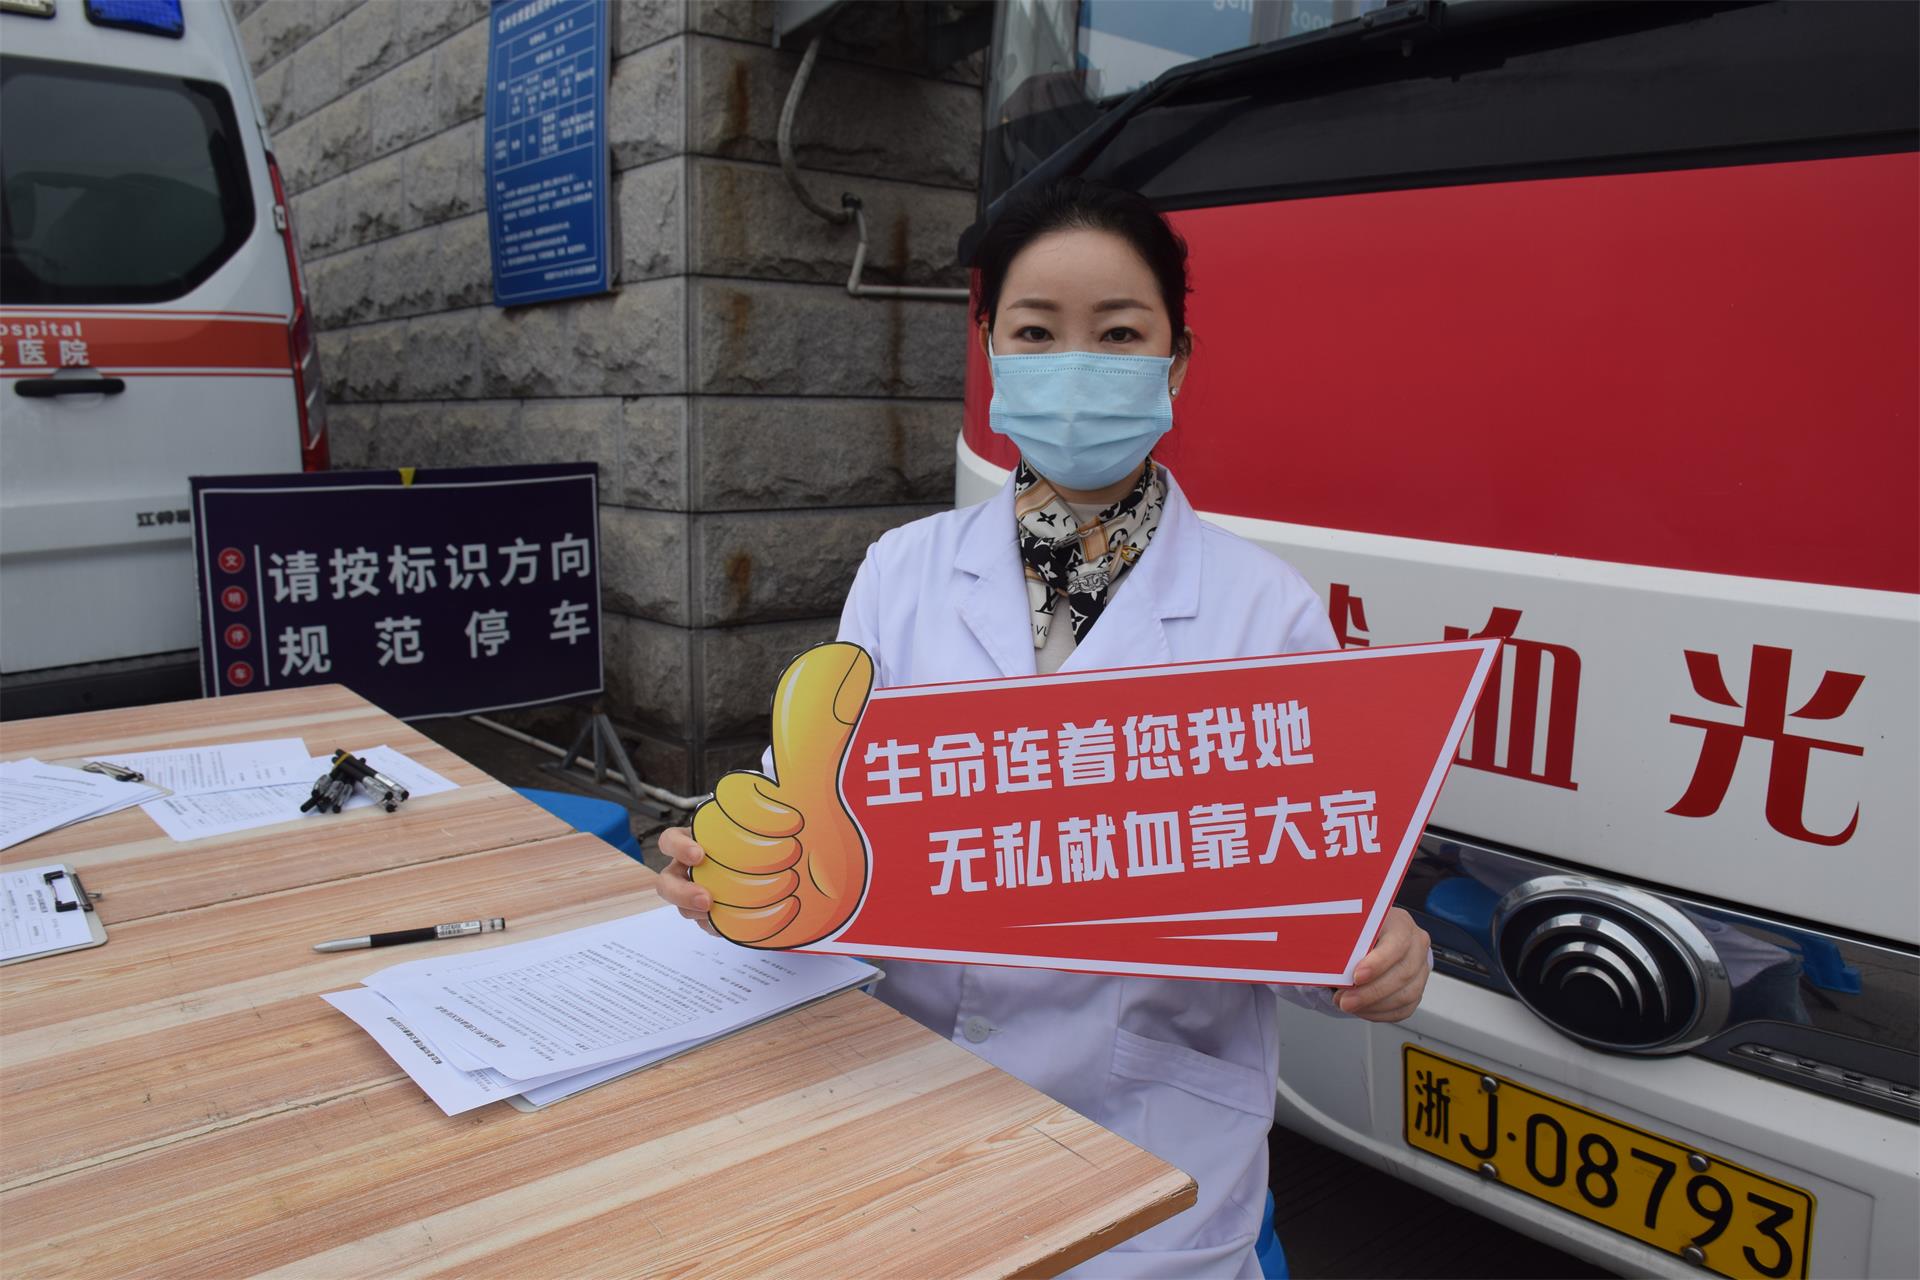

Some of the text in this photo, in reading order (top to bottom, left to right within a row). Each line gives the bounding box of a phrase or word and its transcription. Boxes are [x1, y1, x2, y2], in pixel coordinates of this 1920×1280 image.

[0, 339, 90, 366] 医院
[268, 533, 592, 606] 请按标识方向
[277, 600, 592, 678] 规范停车
[863, 700, 1314, 806] 生命连着您我她
[928, 790, 1382, 896] 无私献血靠大家
